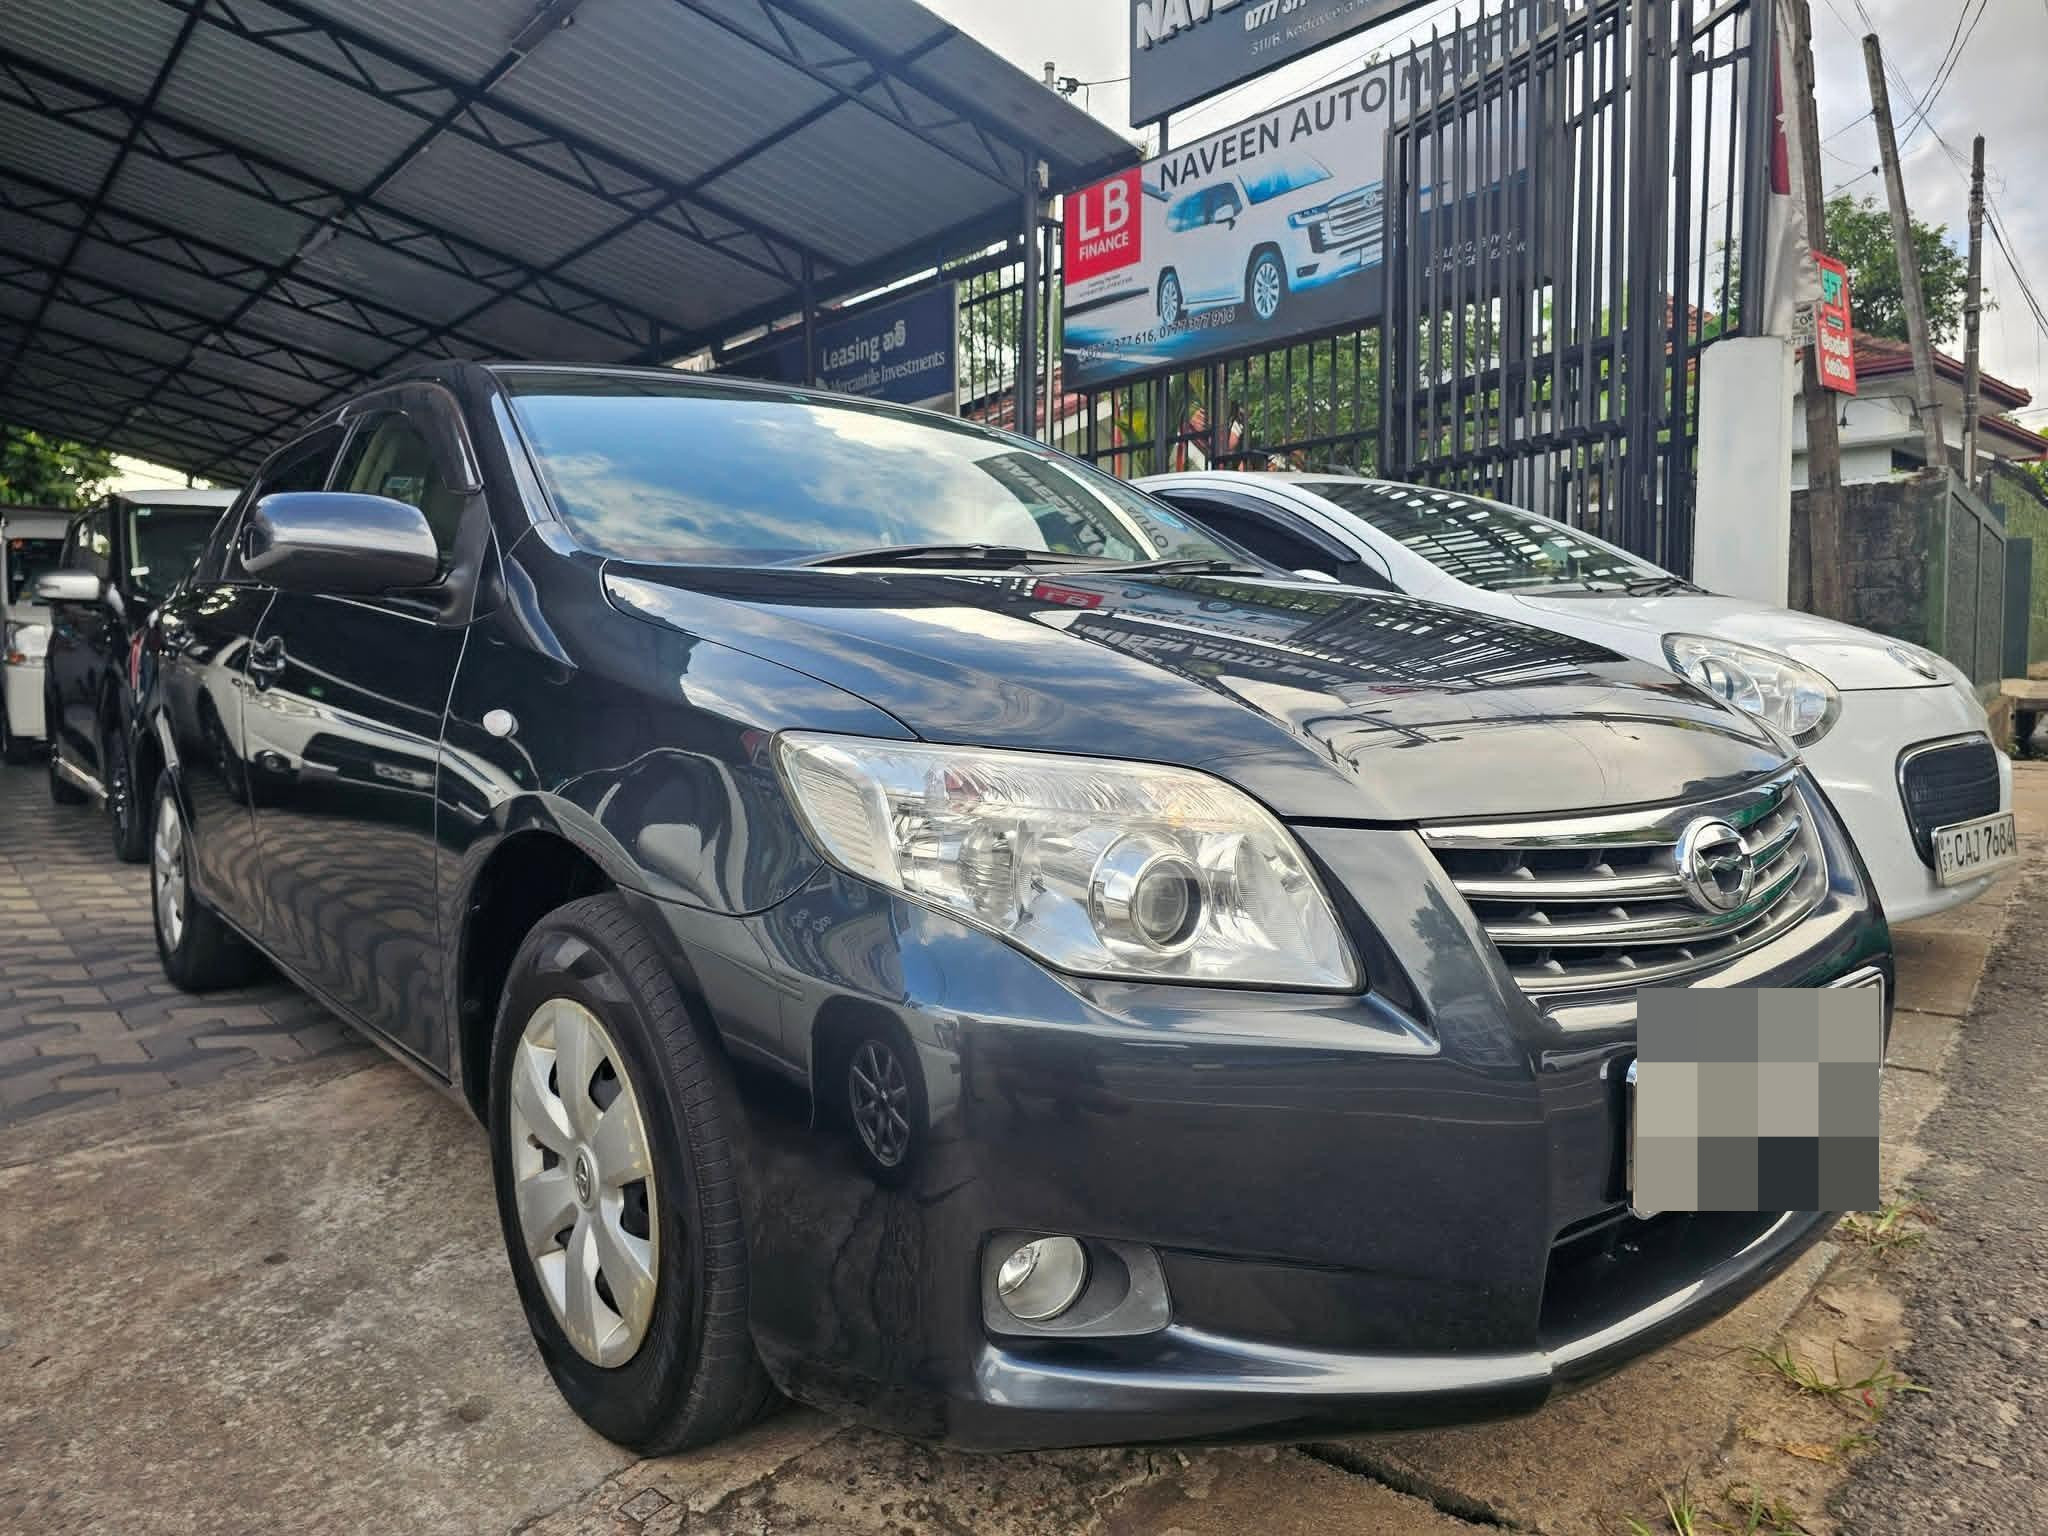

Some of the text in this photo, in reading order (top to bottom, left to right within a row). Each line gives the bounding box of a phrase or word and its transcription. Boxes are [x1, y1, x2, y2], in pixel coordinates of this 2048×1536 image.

[1160, 117, 1280, 192] NAVEEN
[1290, 77, 1387, 143] AUTO
[1079, 180, 1129, 242] LB
[1080, 231, 1129, 261] FINANCE
[823, 336, 880, 372] Leasing
[881, 351, 945, 382] Investments
[1954, 829, 1980, 866] CAJ
